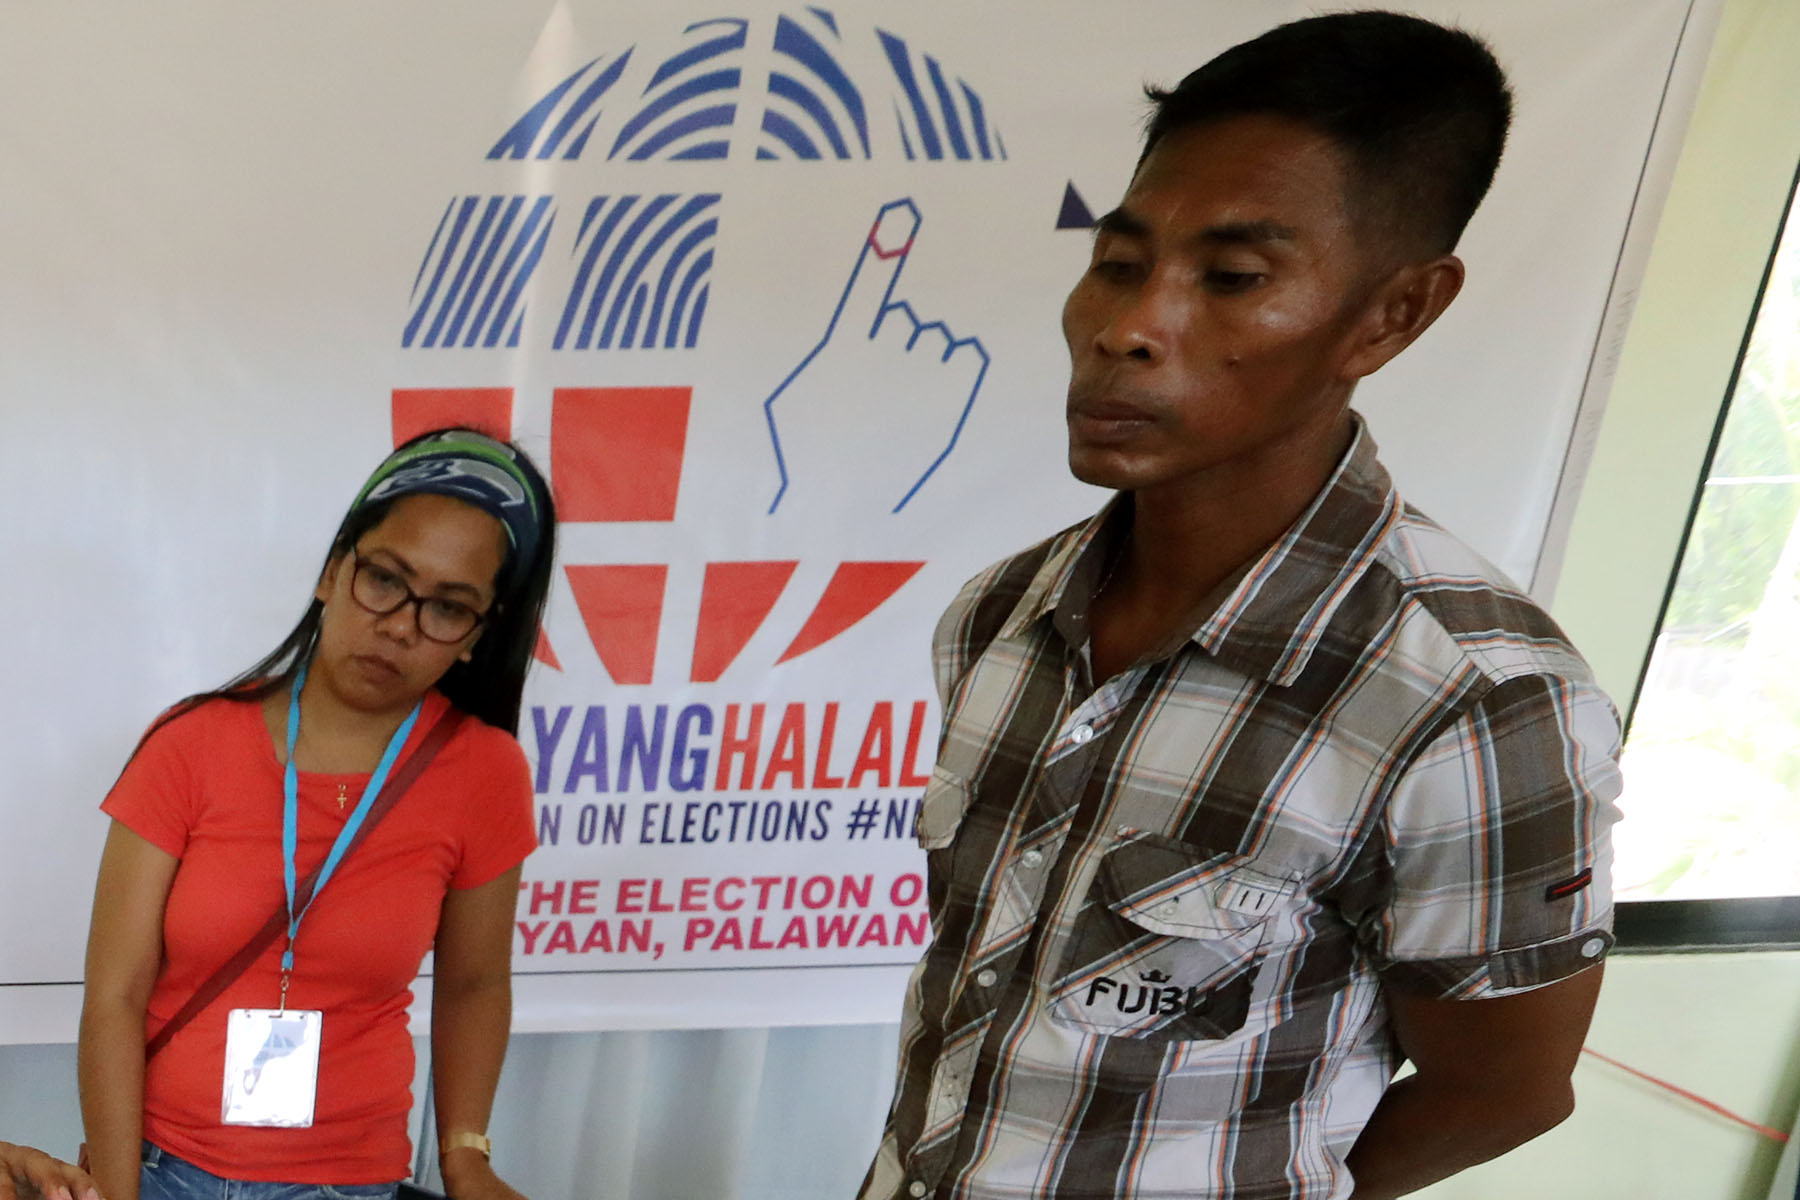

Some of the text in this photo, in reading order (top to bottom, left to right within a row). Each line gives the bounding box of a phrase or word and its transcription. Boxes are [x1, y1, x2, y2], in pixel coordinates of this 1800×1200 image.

[531, 701, 936, 793] YANGHALAL
[576, 803, 626, 844] ON
[640, 800, 833, 844] ELECTIONS
[519, 872, 929, 915] HE ELECTION O
[683, 912, 930, 952] PALAWAN
[1086, 976, 1216, 1016] FUBU
